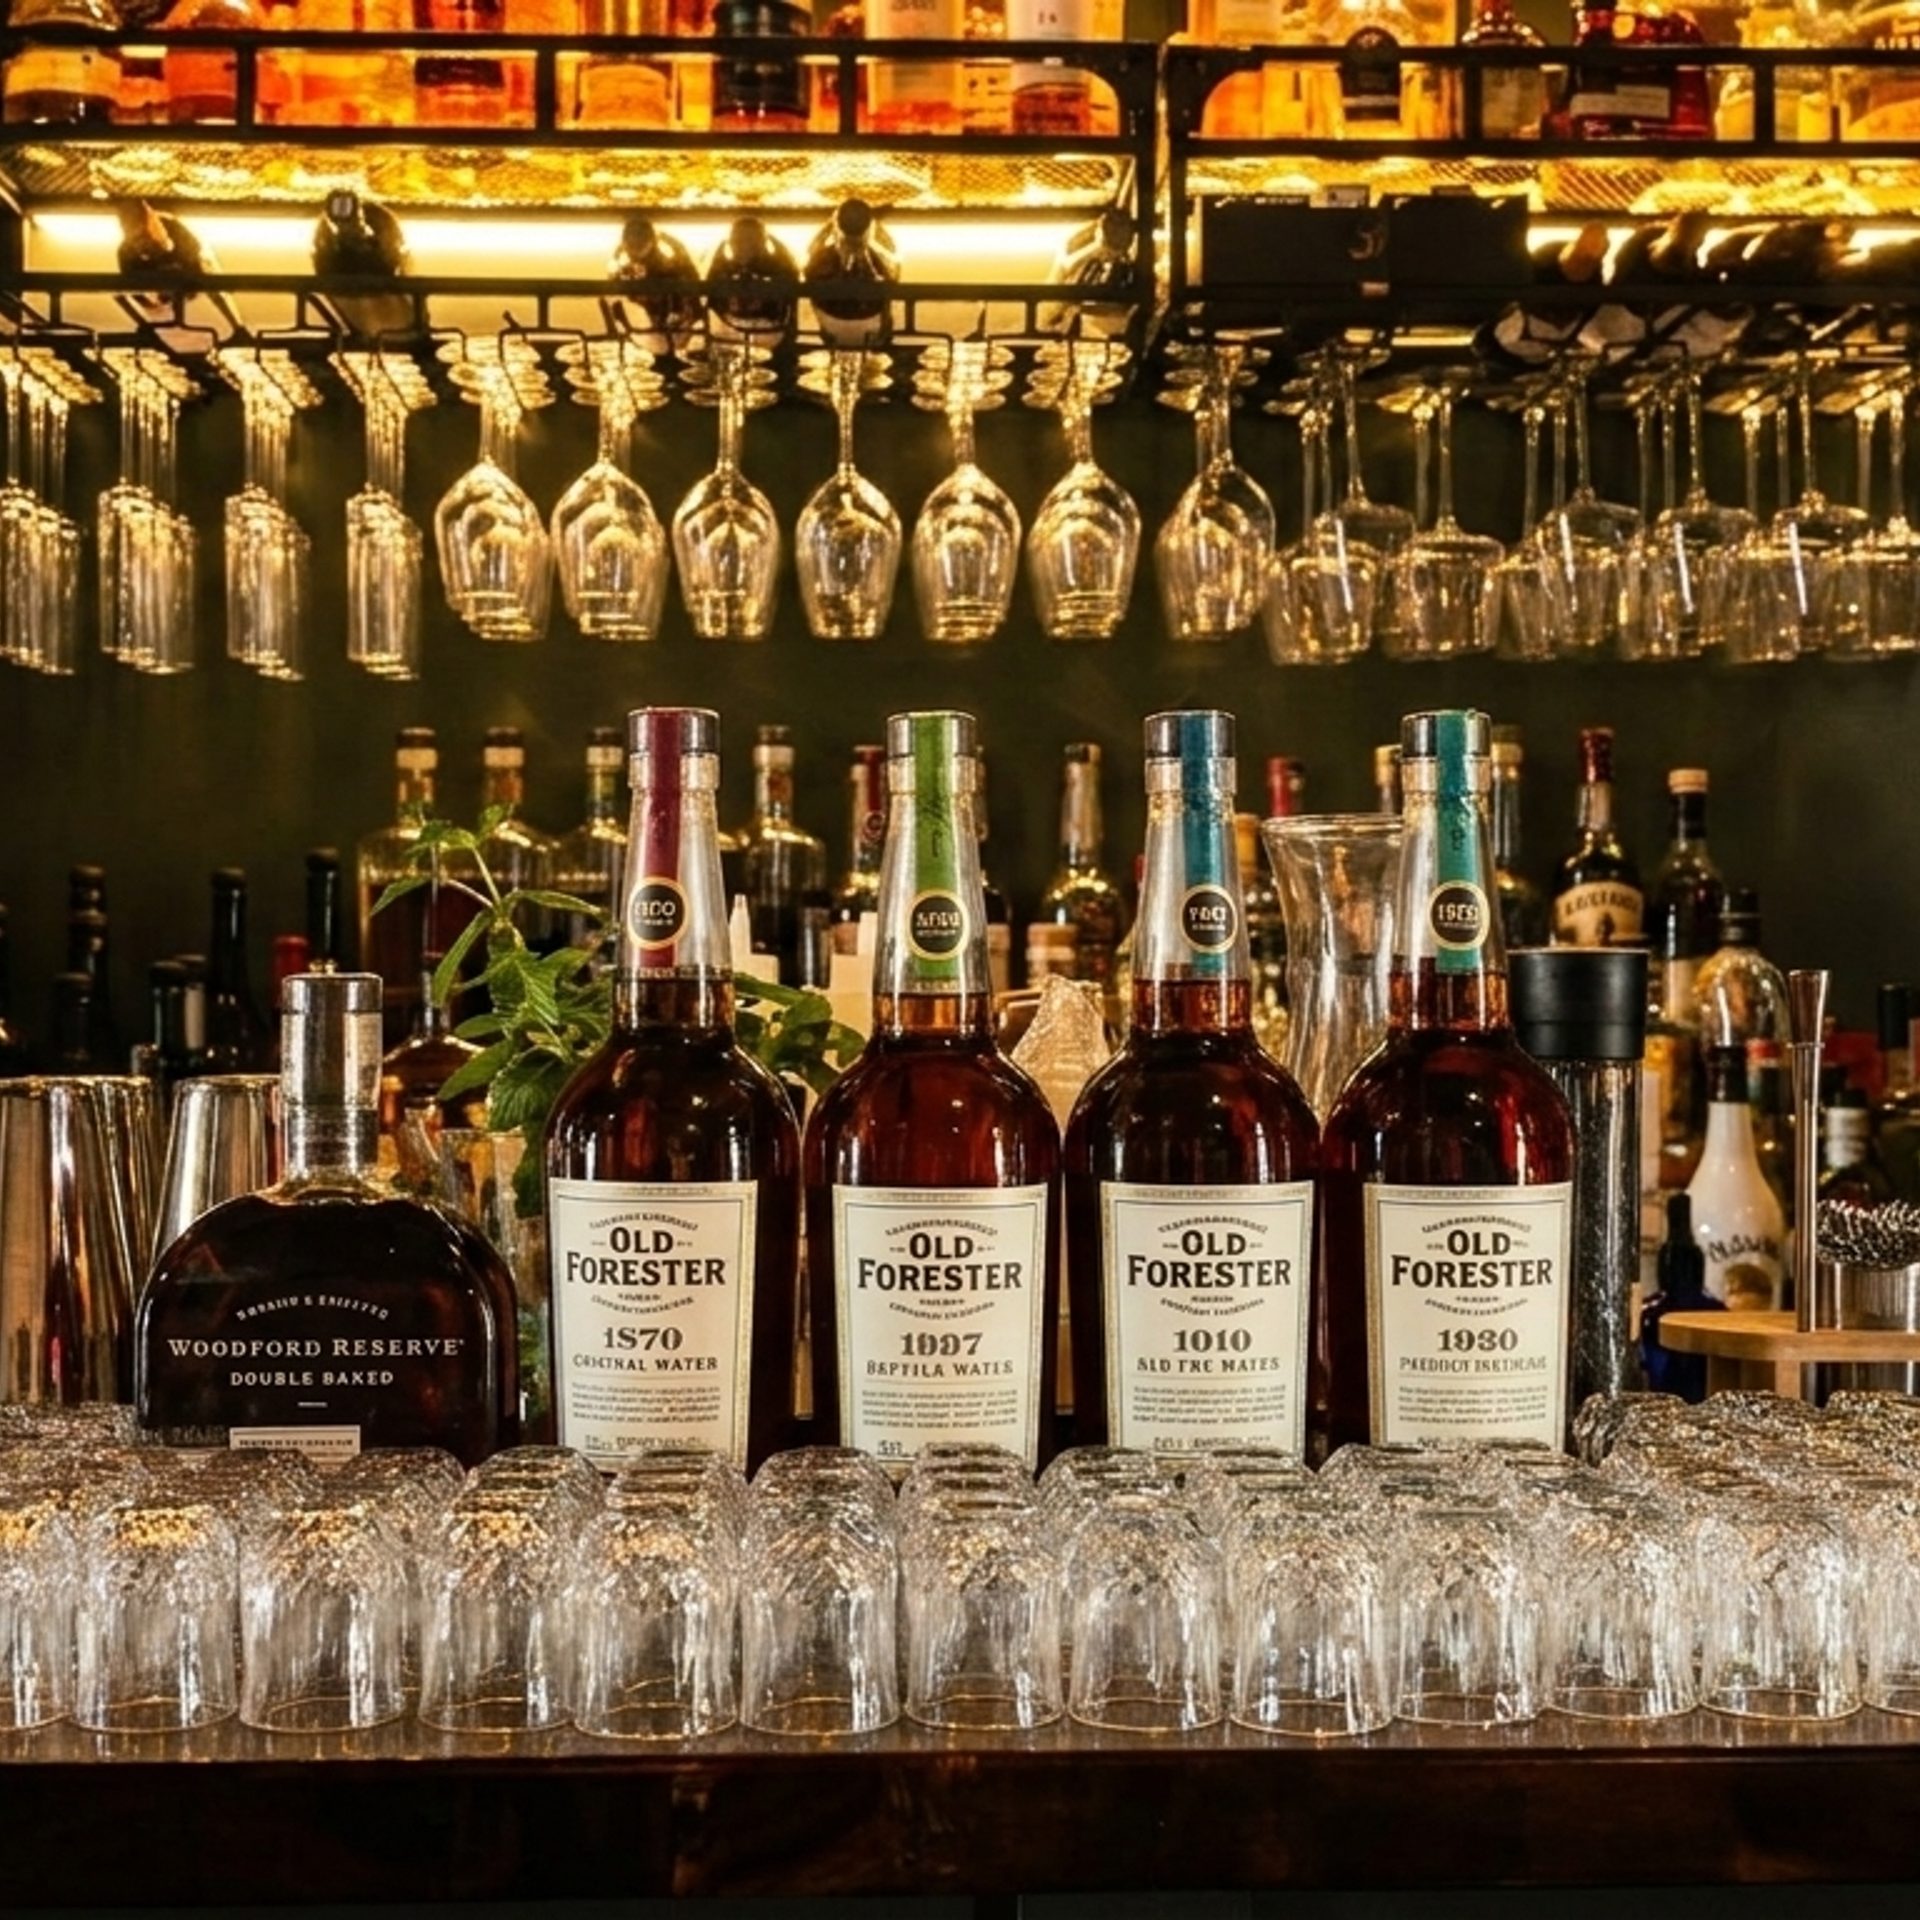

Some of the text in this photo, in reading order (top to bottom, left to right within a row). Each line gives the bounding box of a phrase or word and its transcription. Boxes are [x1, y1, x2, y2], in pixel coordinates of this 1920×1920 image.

[609, 1226, 674, 1254] OLD
[909, 1232, 974, 1260] OLD
[1181, 1229, 1246, 1256] OLD
[1447, 1229, 1511, 1256] OLD
[566, 1251, 726, 1286] FORESTER
[857, 1257, 1023, 1291] FORESTER
[1127, 1254, 1291, 1288] FORESTER
[1391, 1254, 1553, 1289] FORESTER
[167, 1337, 461, 1358] WOODFORD RESERVE
[654, 1356, 719, 1371] WATER
[230, 1370, 394, 1386] DOUBLE BAKED
